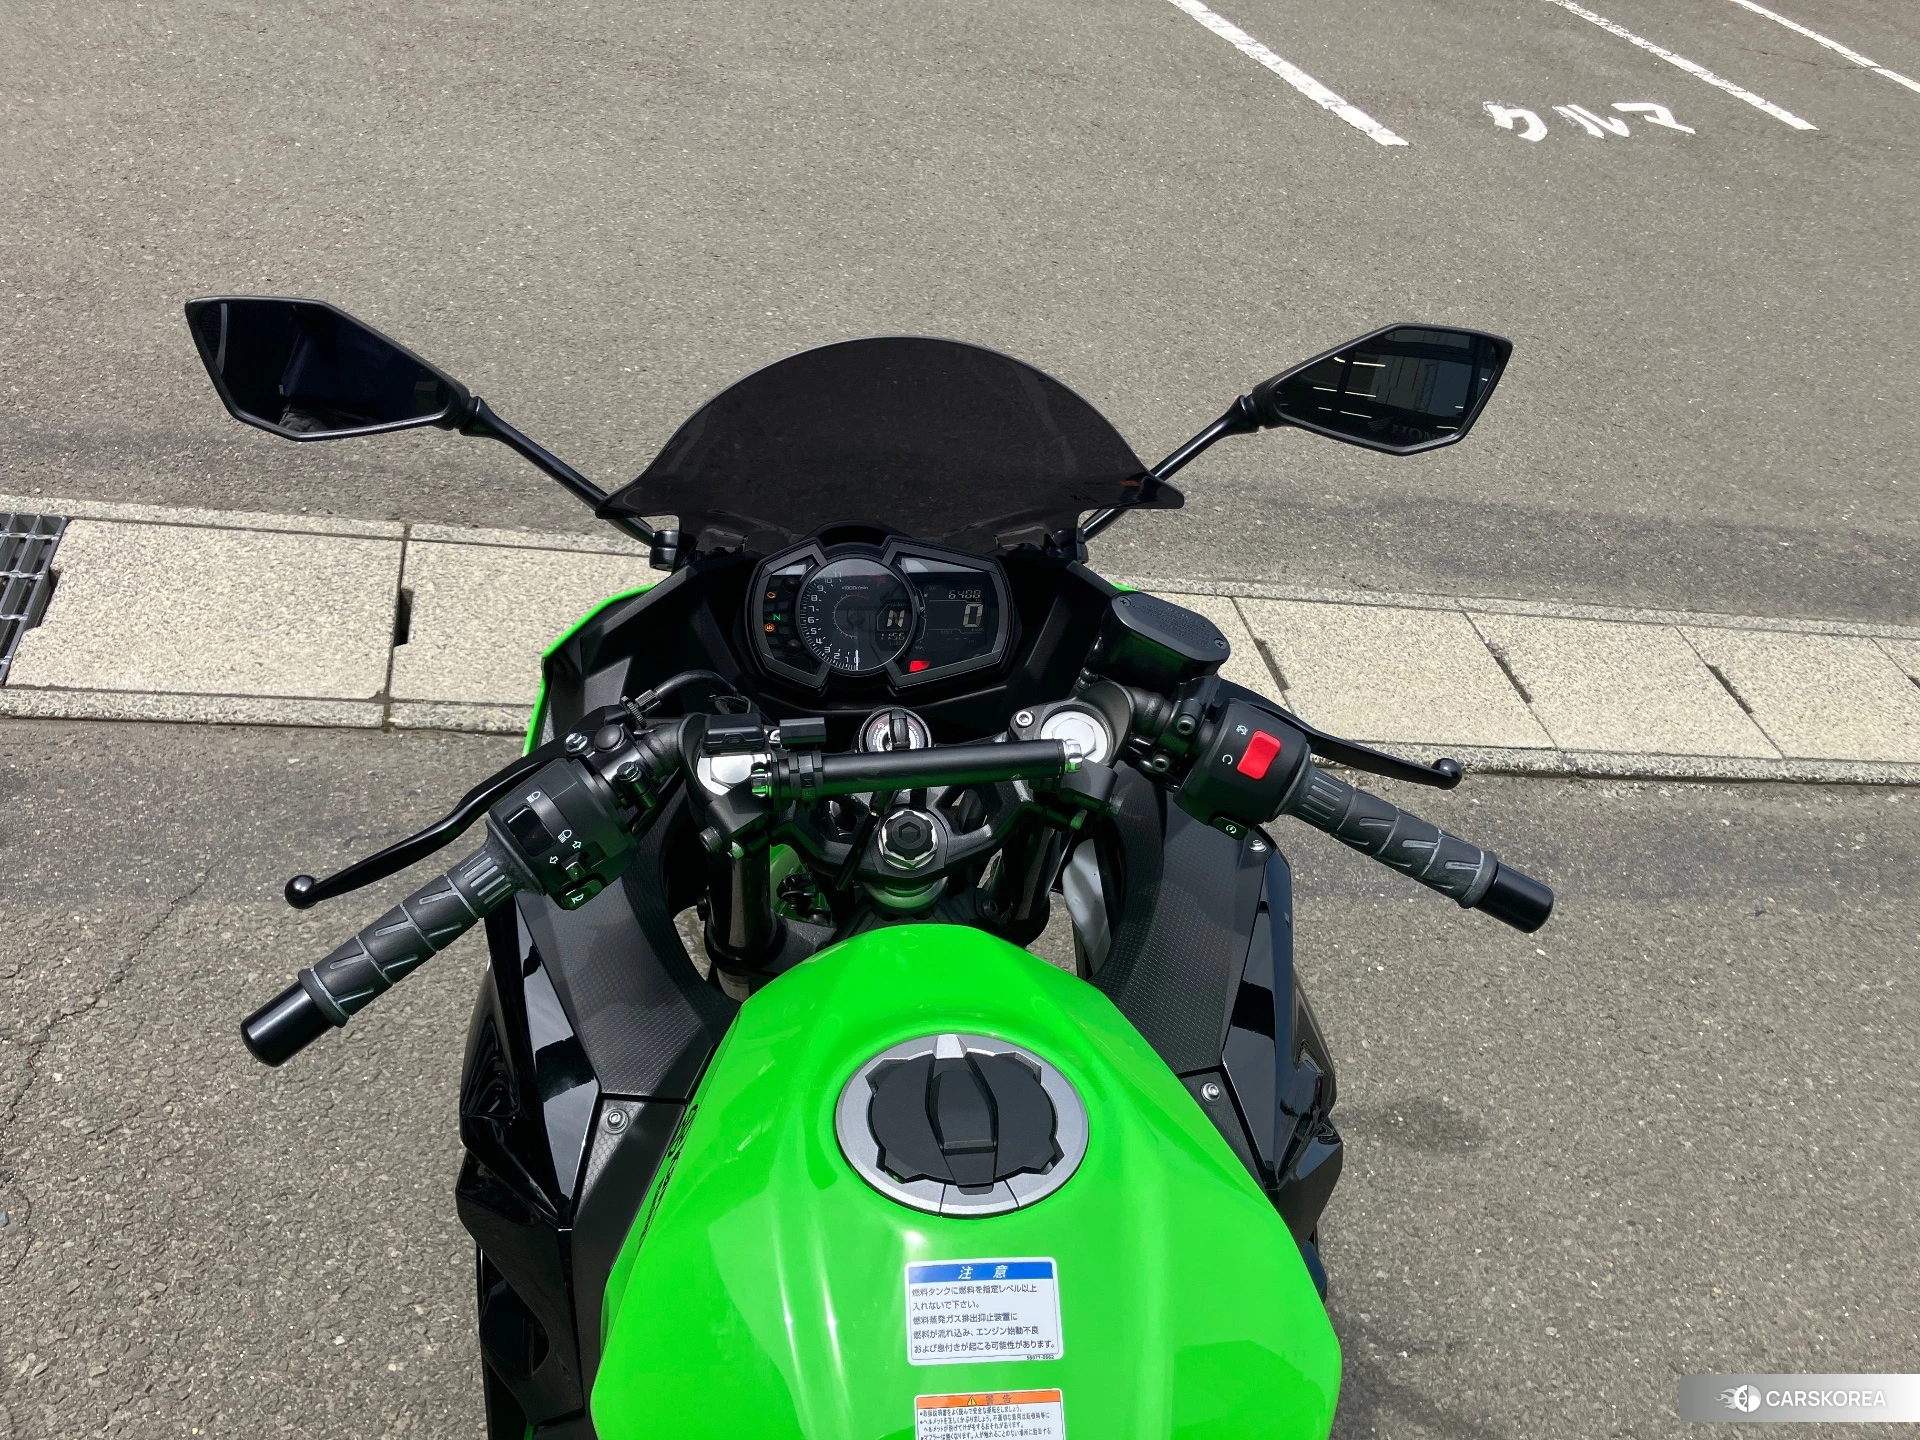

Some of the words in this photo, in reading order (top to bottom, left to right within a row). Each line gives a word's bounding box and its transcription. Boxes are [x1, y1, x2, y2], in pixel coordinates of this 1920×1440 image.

[810, 594, 818, 602] 8
[887, 609, 905, 628] N
[963, 603, 984, 628] 0
[958, 1265, 1008, 1280] 注意
[911, 1283, 1038, 1297] 燃料タンクに燃料を指定レベル以上
[912, 1300, 980, 1311] 入れないで下さい。
[913, 1312, 1018, 1326] 燃料蒸発ガス排出抑止装置に
[913, 1326, 1039, 1340] 燃料が流れ込み、エンジン始動不良
